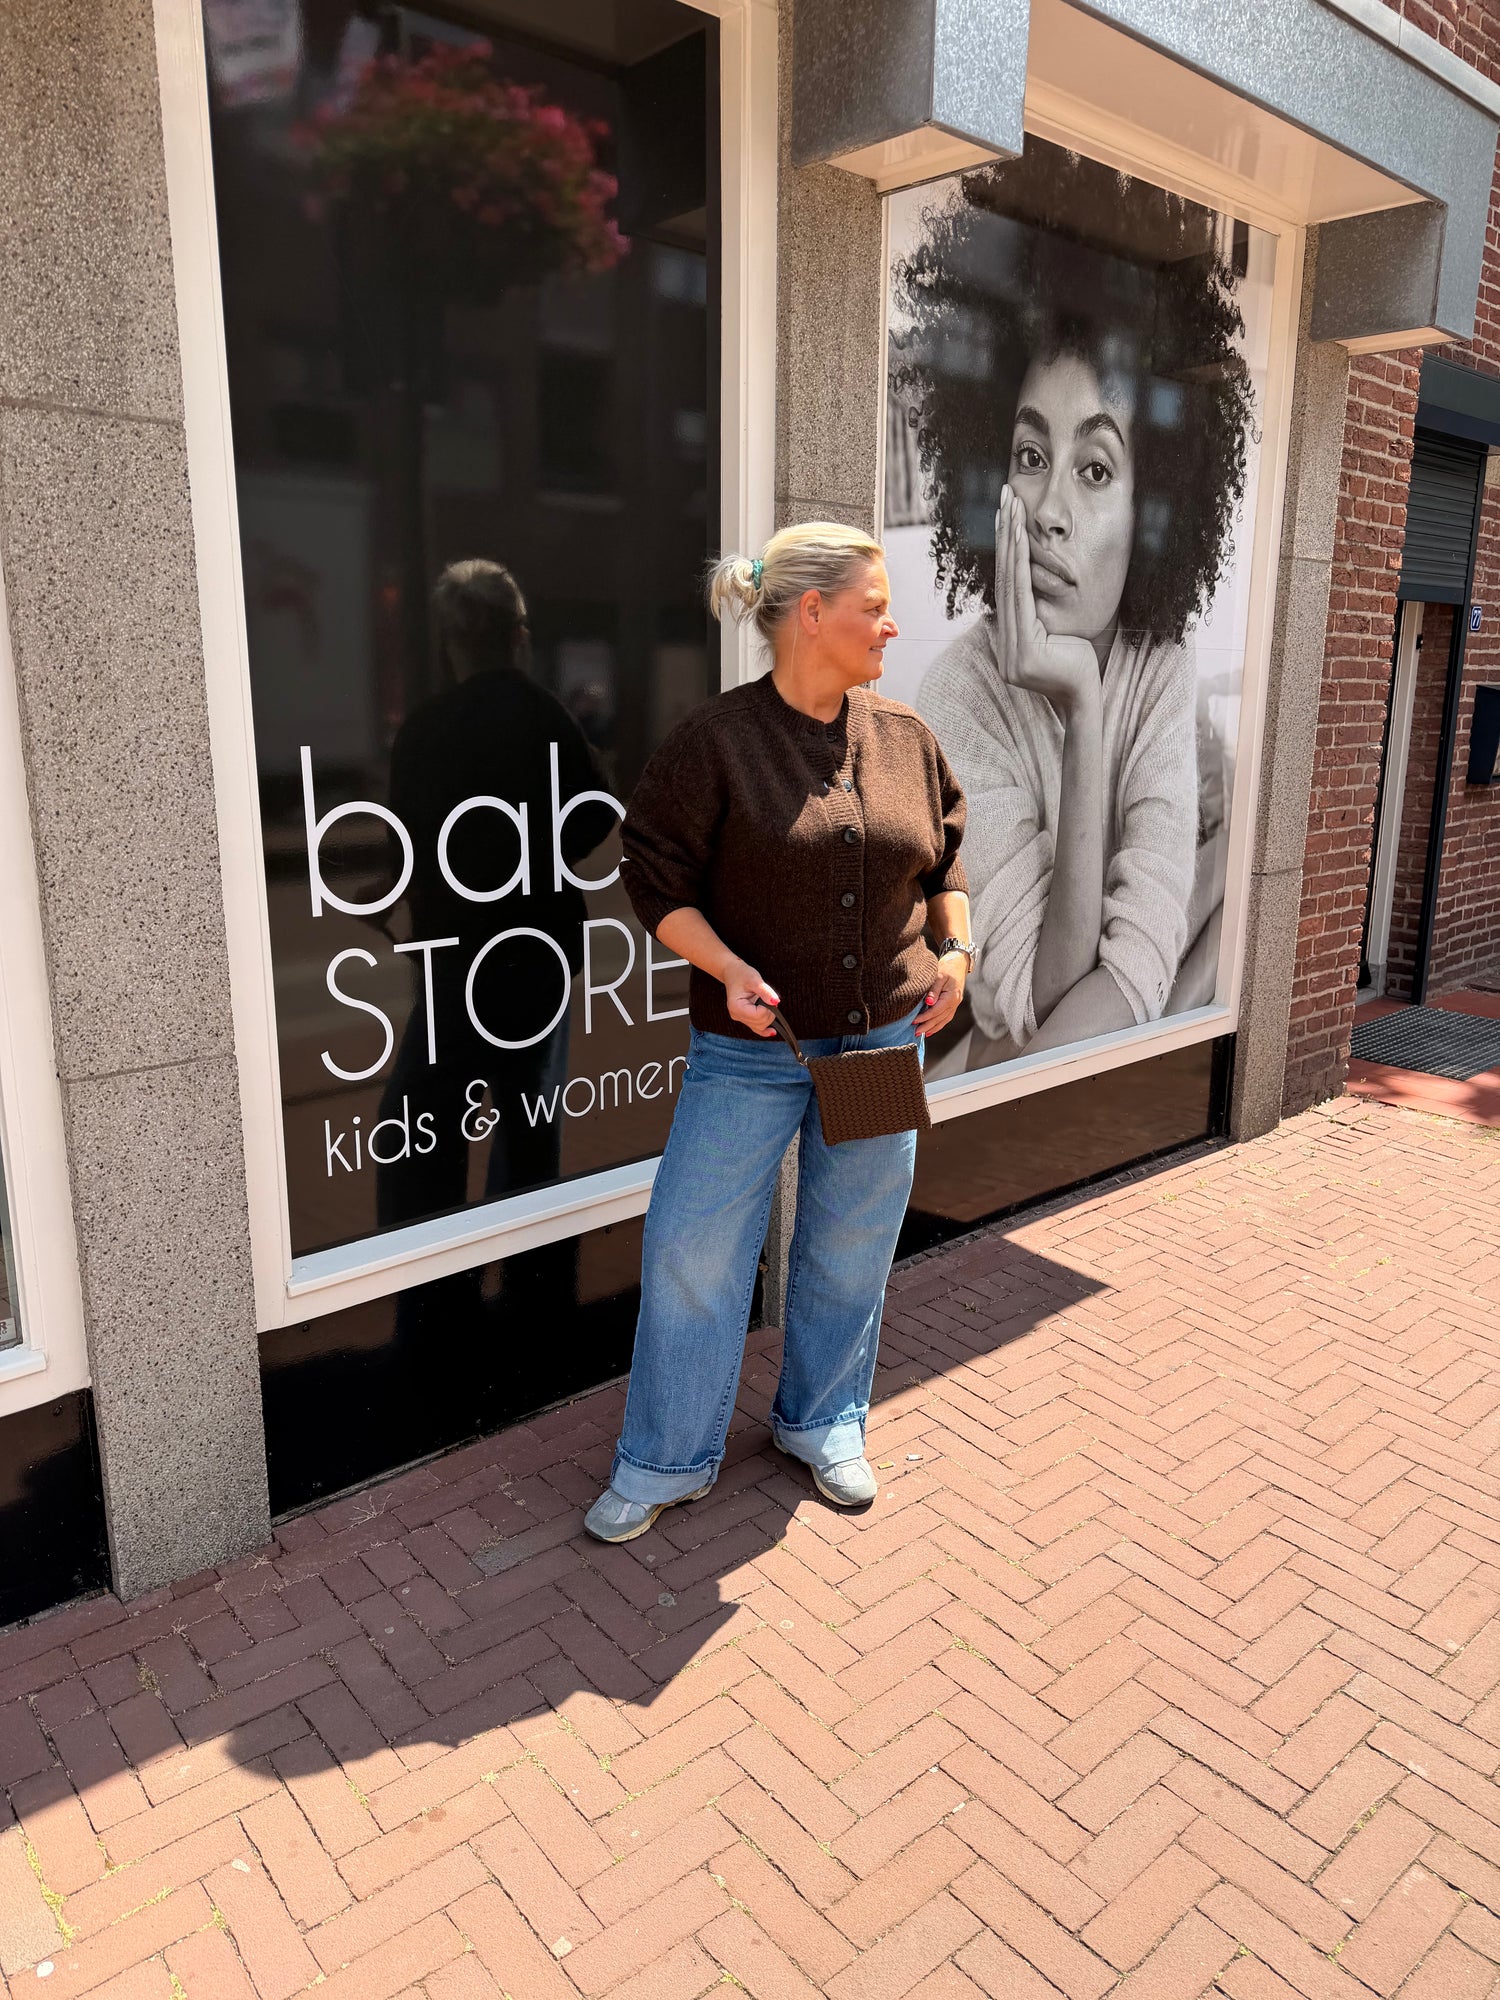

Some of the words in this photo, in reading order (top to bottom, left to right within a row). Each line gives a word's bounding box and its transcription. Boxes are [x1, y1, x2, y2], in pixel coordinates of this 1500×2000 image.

[321, 917, 690, 1080] STORE
[324, 1095, 437, 1177] kids
[460, 1079, 501, 1142] &
